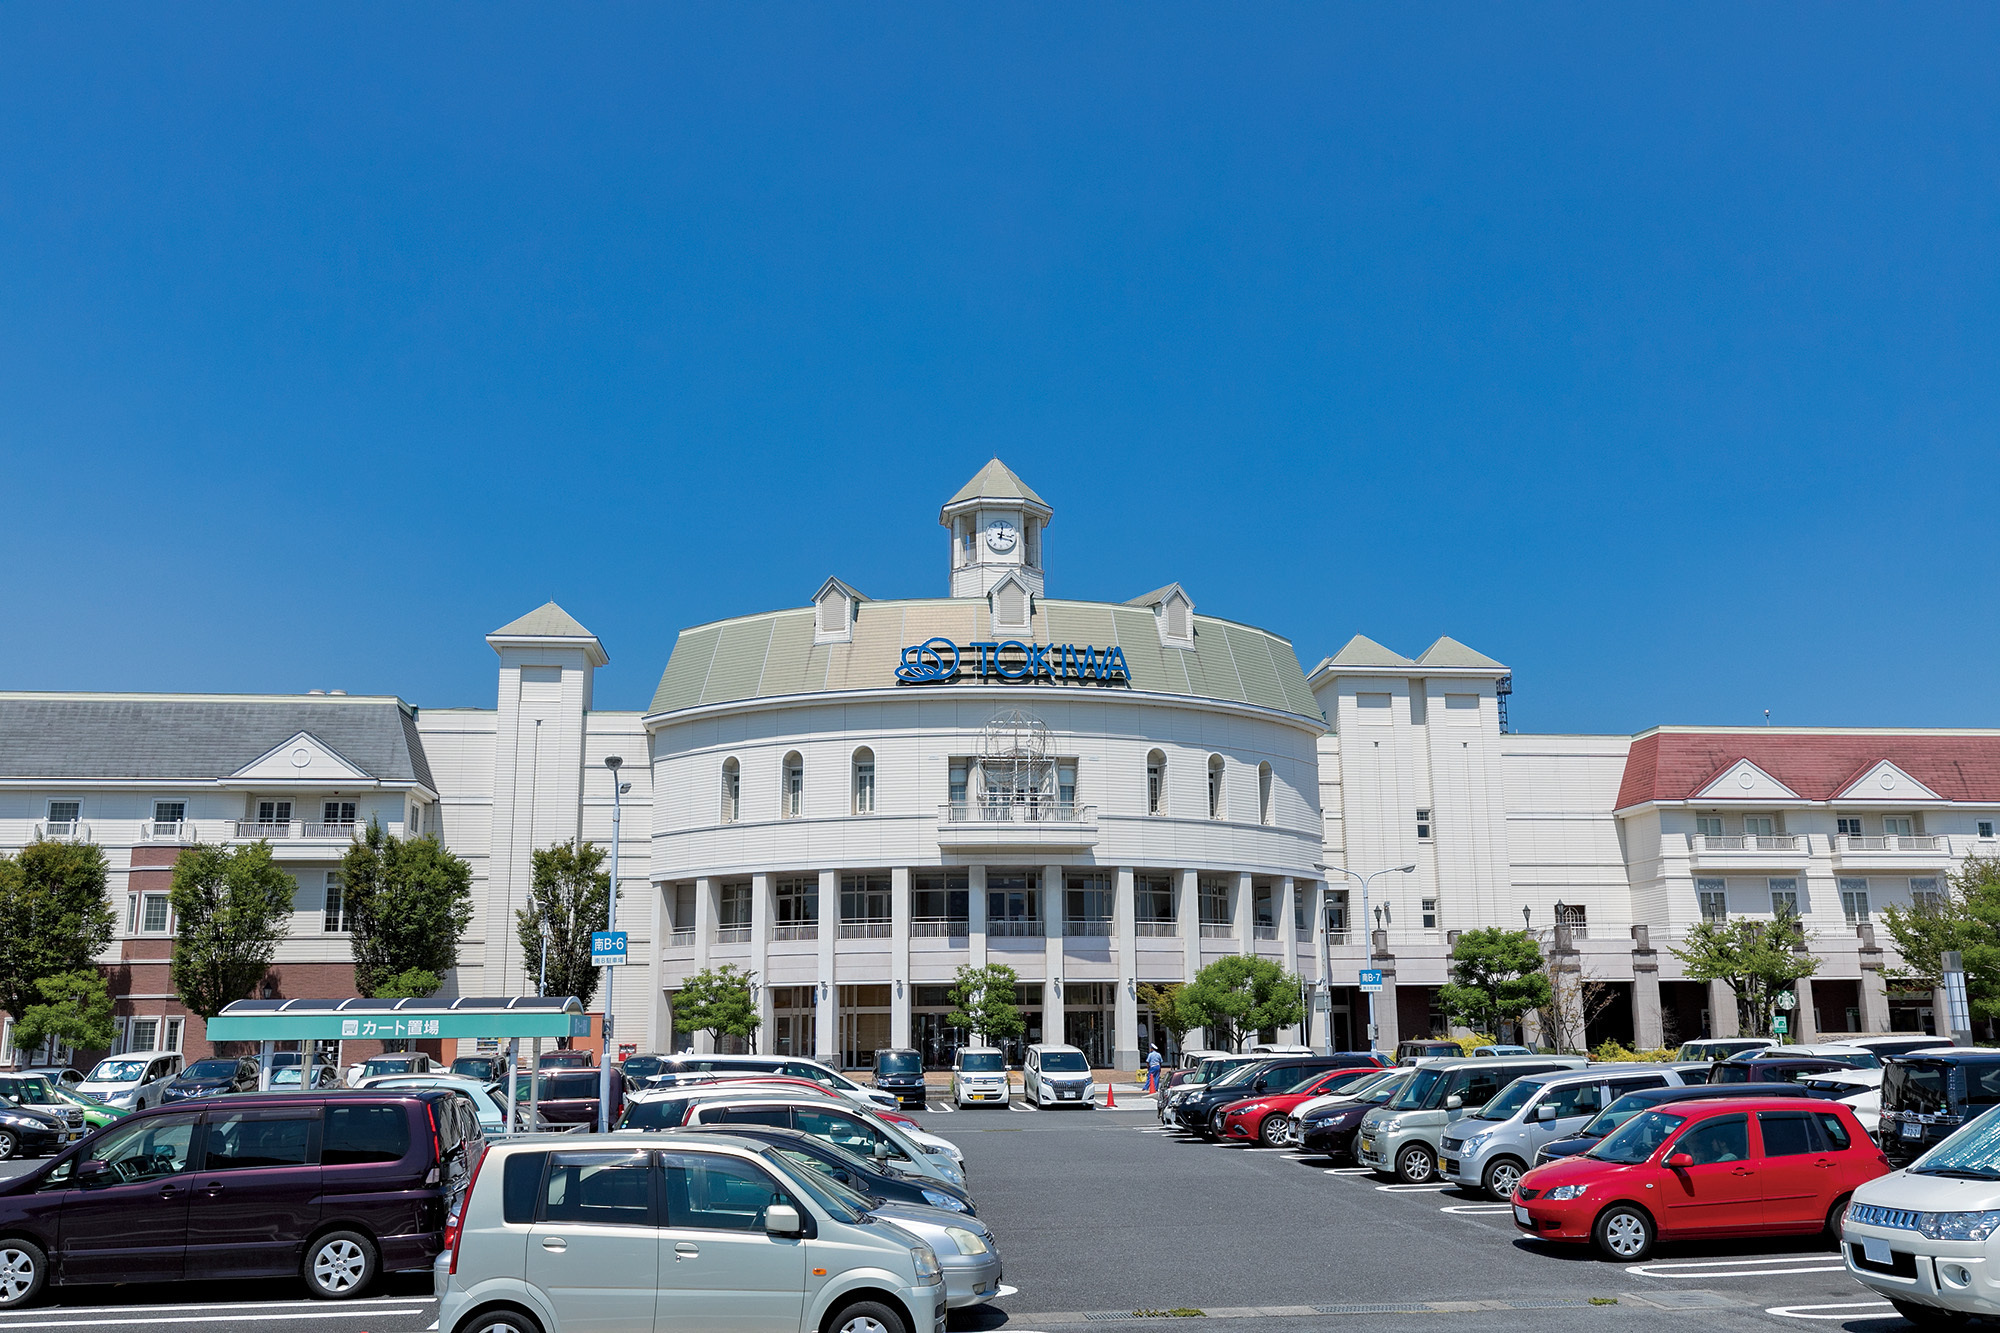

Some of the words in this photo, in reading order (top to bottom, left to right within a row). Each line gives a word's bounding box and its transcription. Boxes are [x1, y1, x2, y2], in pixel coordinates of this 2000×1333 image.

[970, 640, 1132, 681] TOKIWA
[594, 937, 624, 951] 南B-6
[362, 1020, 439, 1036] カート置場
